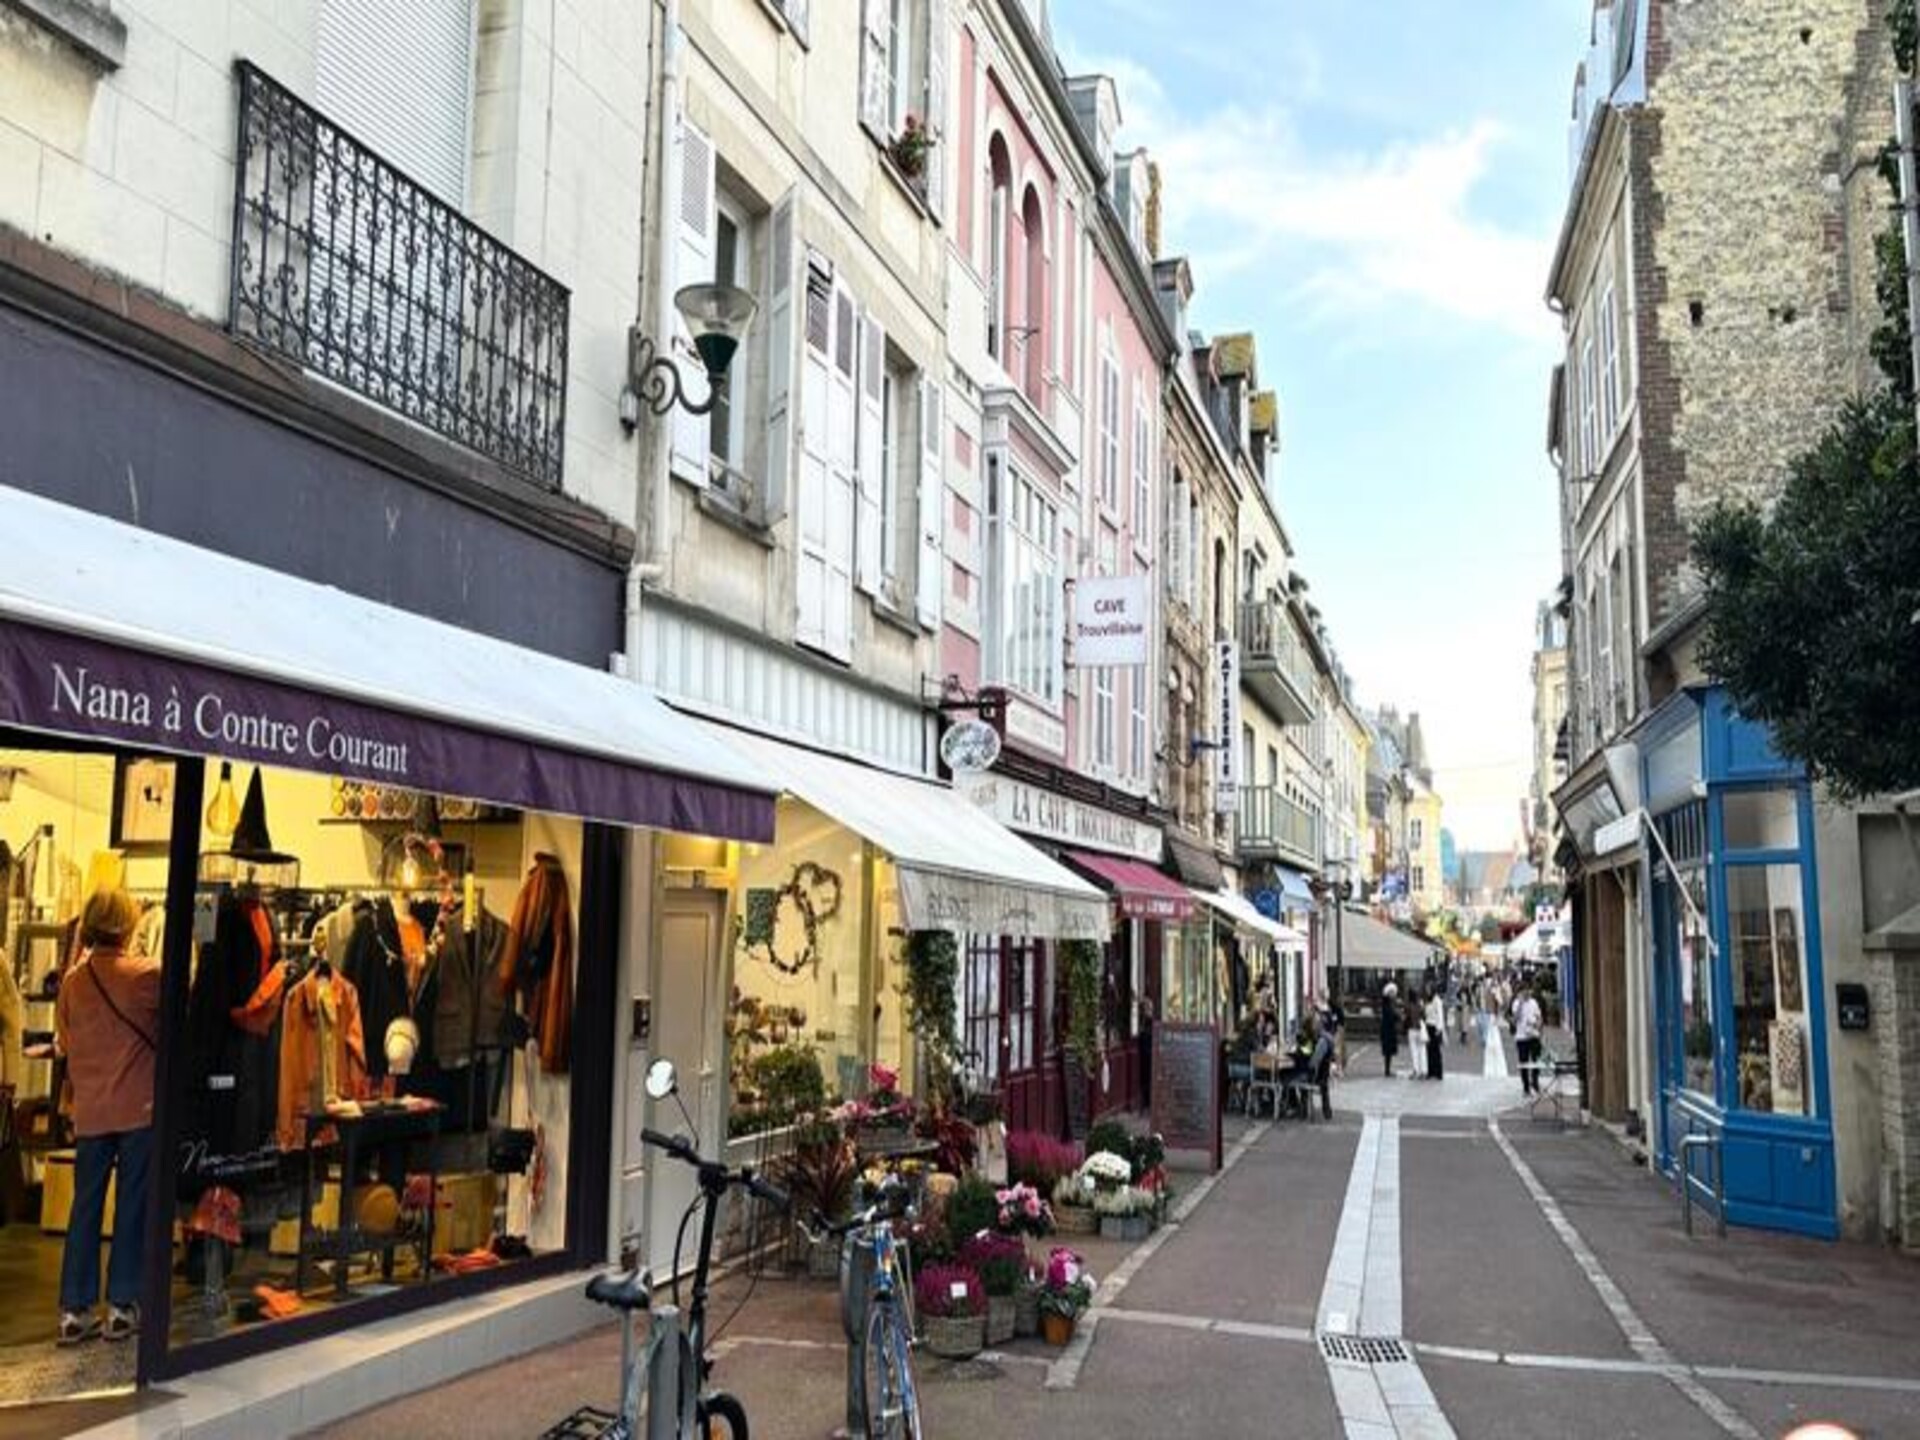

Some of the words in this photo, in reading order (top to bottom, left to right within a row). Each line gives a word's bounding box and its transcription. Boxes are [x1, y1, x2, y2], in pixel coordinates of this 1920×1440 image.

[1093, 597, 1126, 614] CAVE
[51, 661, 152, 728] Nana
[163, 685, 183, 732] à
[193, 692, 300, 754] Contre
[305, 715, 409, 774] Courant
[1220, 643, 1232, 777] PATISSERIE
[1012, 784, 1031, 824] LA
[1038, 791, 1070, 835] CAVE
